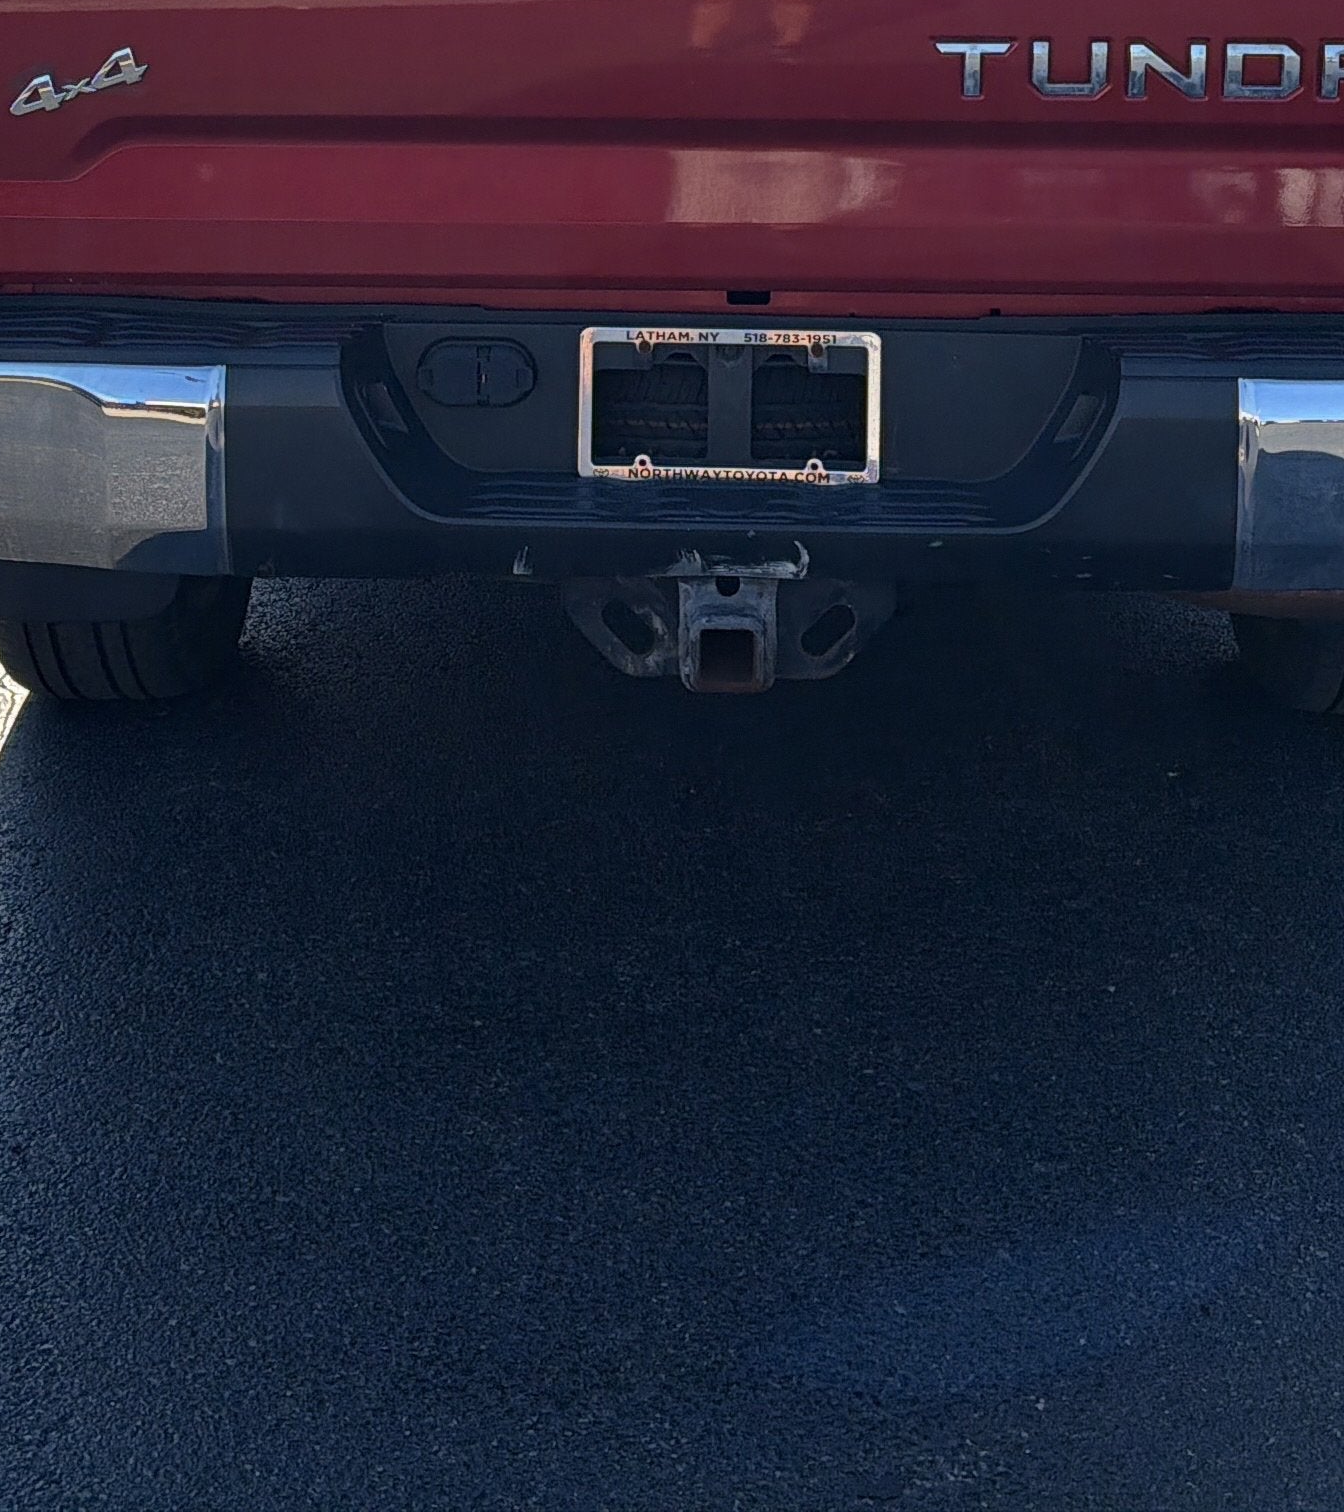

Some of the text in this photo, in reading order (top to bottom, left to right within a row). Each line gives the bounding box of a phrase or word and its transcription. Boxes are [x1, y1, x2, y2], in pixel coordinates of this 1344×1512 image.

[9, 47, 149, 116] 4x4
[699, 331, 720, 343] NY
[743, 332, 837, 345] 518-783-1951
[627, 467, 831, 485] NORTHWAYTOYOTA.COM
